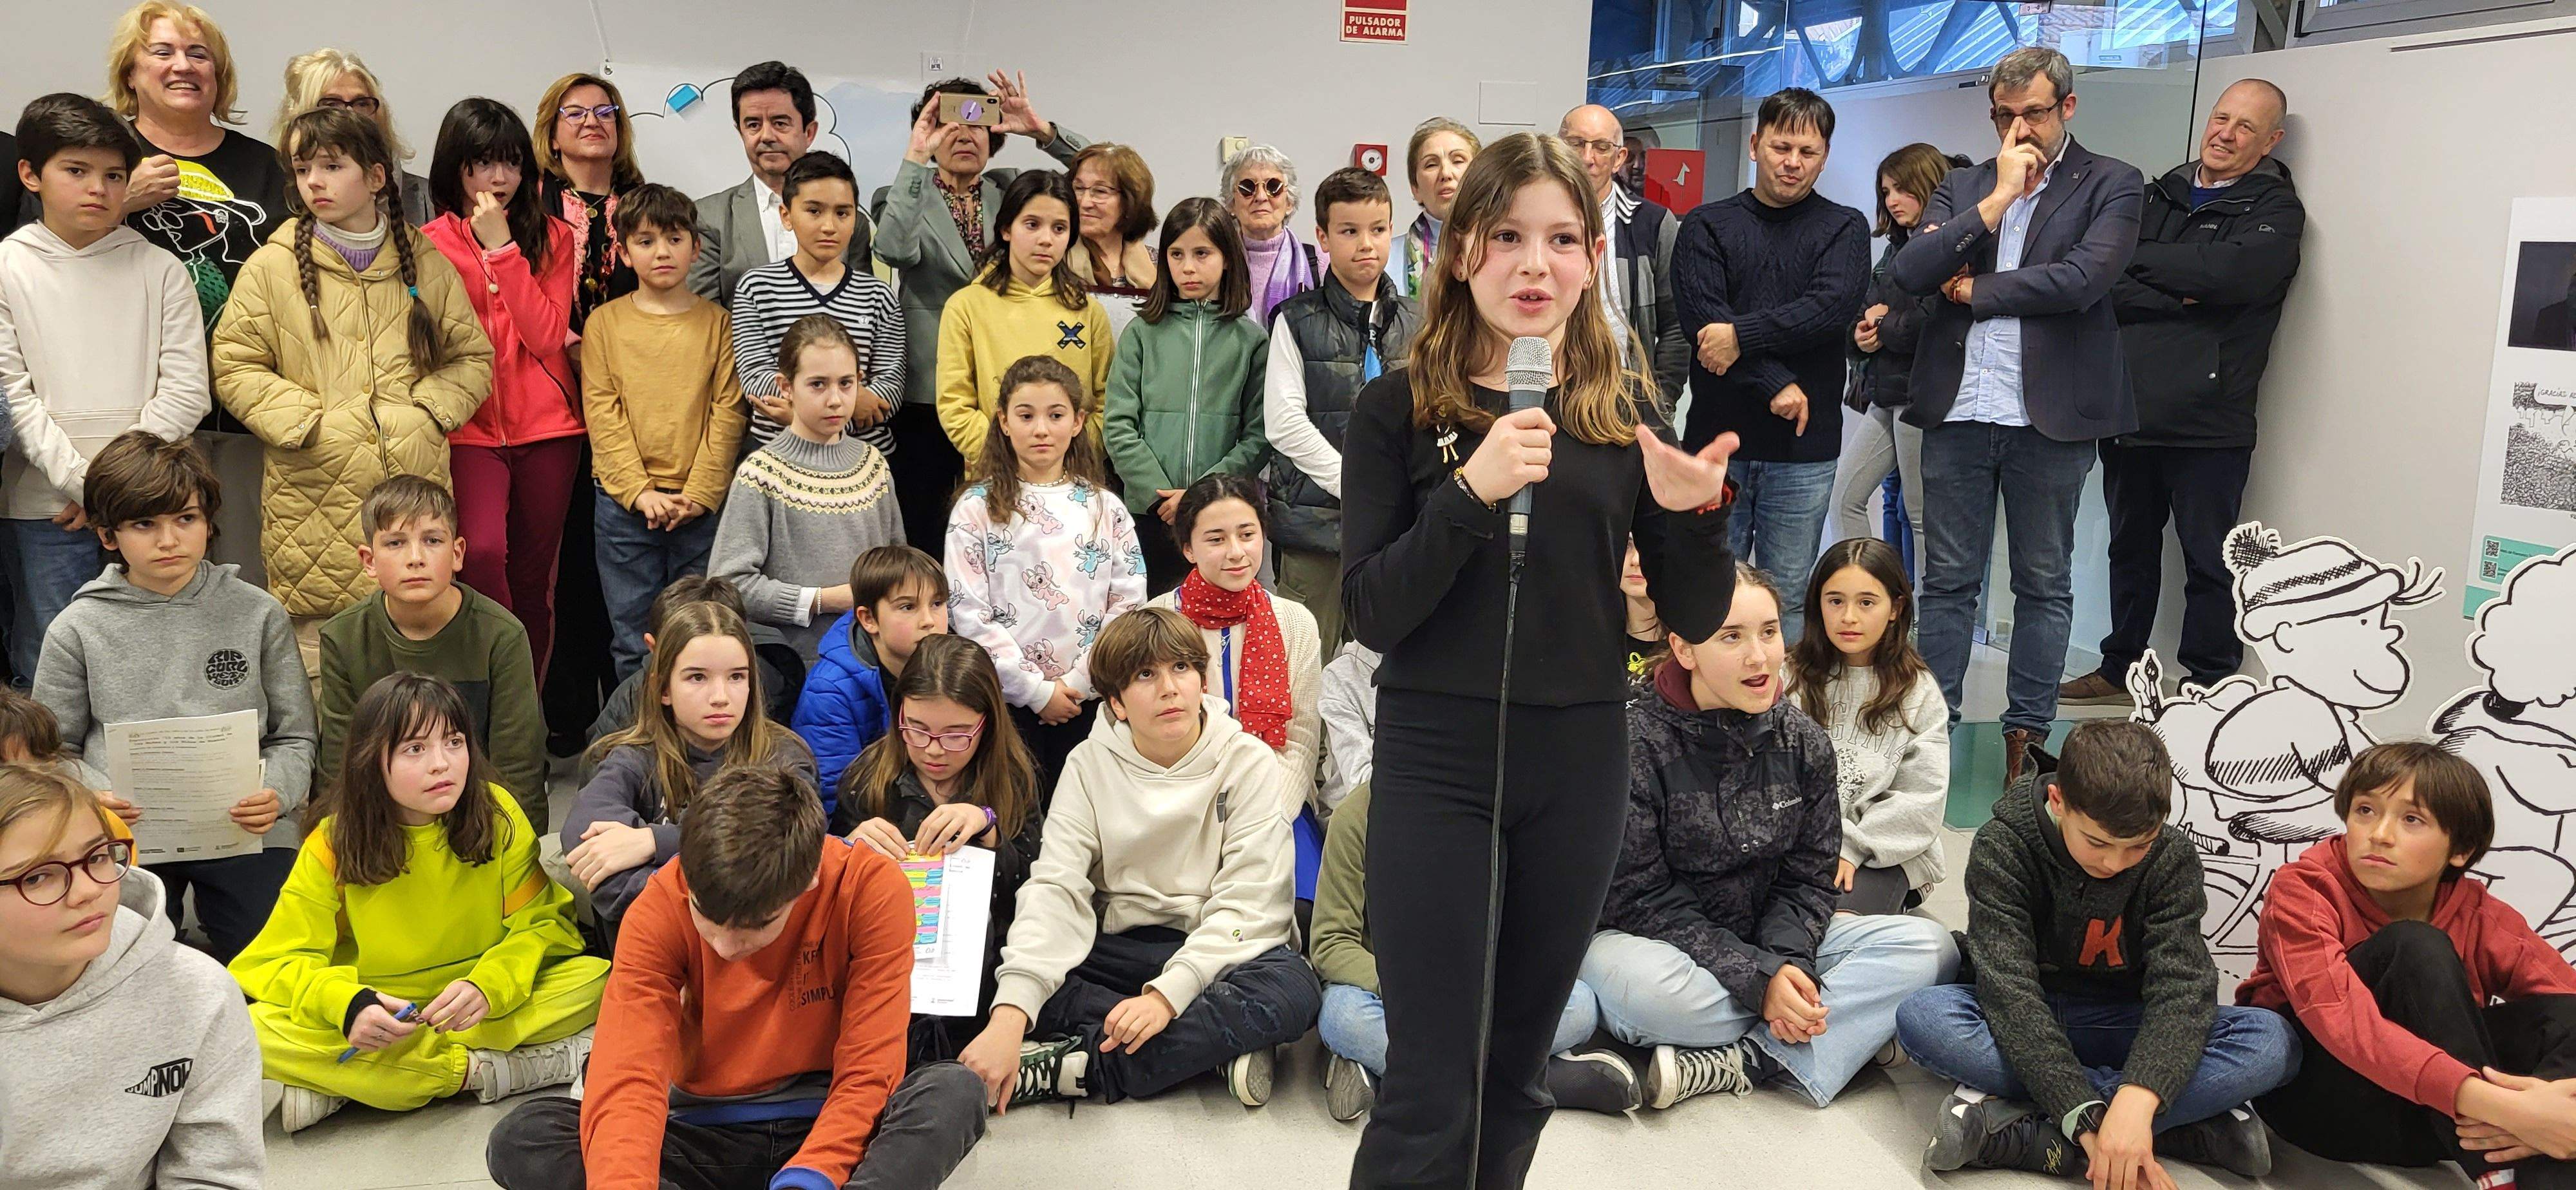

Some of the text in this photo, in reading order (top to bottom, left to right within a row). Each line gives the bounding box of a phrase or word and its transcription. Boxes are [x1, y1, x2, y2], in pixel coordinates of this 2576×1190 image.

[1349, 15, 1401, 27] PULSADOR
[1346, 25, 1403, 37] DE ALARMA
[208, 650, 243, 664] RIP
[206, 661, 248, 674] CURL
[2078, 915, 2124, 967] K
[801, 987, 835, 1006] SIMPL
